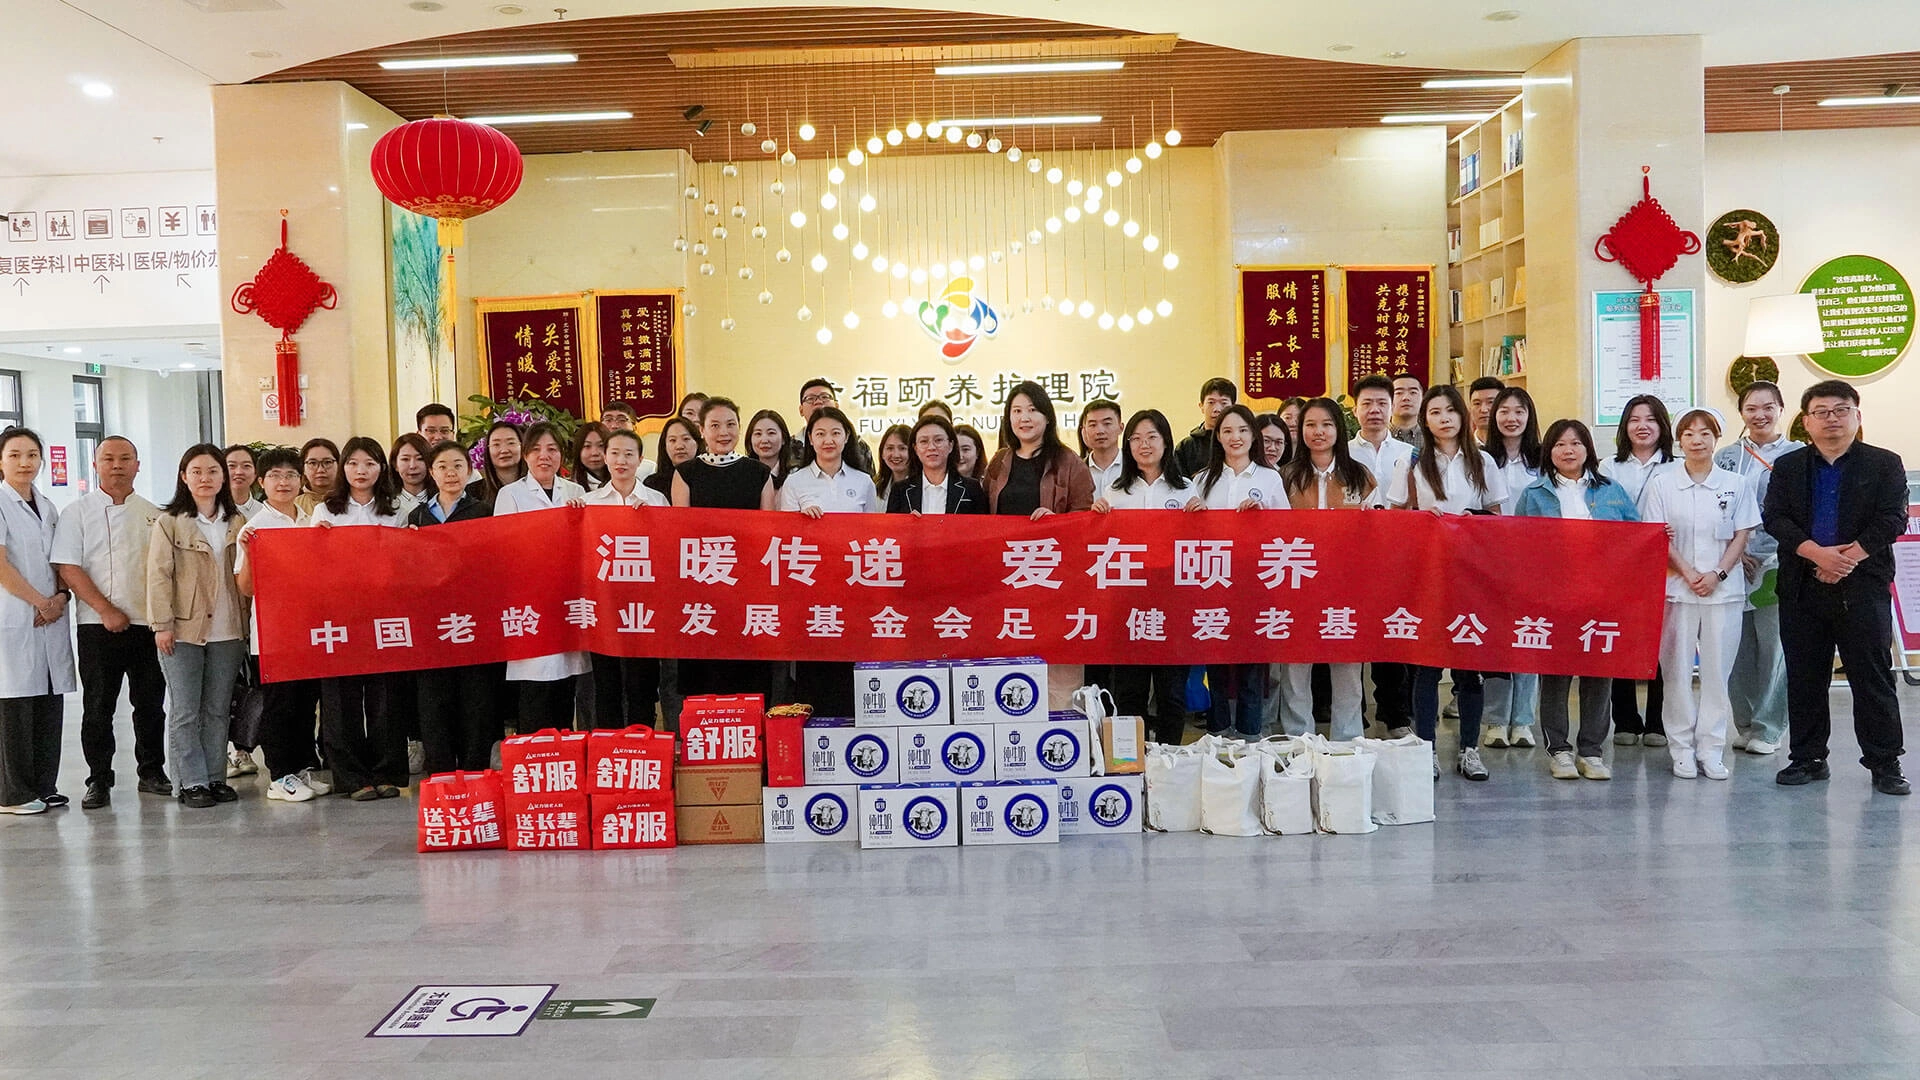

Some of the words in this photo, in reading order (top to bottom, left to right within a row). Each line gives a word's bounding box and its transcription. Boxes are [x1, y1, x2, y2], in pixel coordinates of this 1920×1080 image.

[1266, 283, 1285, 379] 服务一流
[1283, 281, 1302, 379] 情系长者
[620, 308, 637, 400] 真情温暖夕阳红
[833, 369, 1120, 407] 福颐养护理院
[597, 533, 907, 588] 温暖传递
[1002, 535, 1319, 590] 爱在颐养
[310, 597, 1621, 654] 中国老龄事业发展基金会足力健爱老基金公益行
[863, 692, 886, 709] 纯牛奶
[962, 690, 985, 706] 纯牛奶
[687, 725, 757, 761] 舒服
[1003, 746, 1026, 762] 纯牛奶
[812, 751, 835, 767] 纯牛奶
[908, 749, 931, 765] 纯牛奶
[512, 760, 578, 794] 舒服
[596, 757, 662, 791] 舒服
[423, 801, 497, 827] 送长辈
[515, 811, 578, 832] 送长辈
[772, 809, 794, 825] 纯牛奶
[869, 813, 892, 830] 纯牛奶
[971, 811, 994, 827] 纯牛奶
[425, 822, 500, 847] 足力健
[516, 830, 578, 848] 足力健
[602, 811, 667, 844] 舒服
